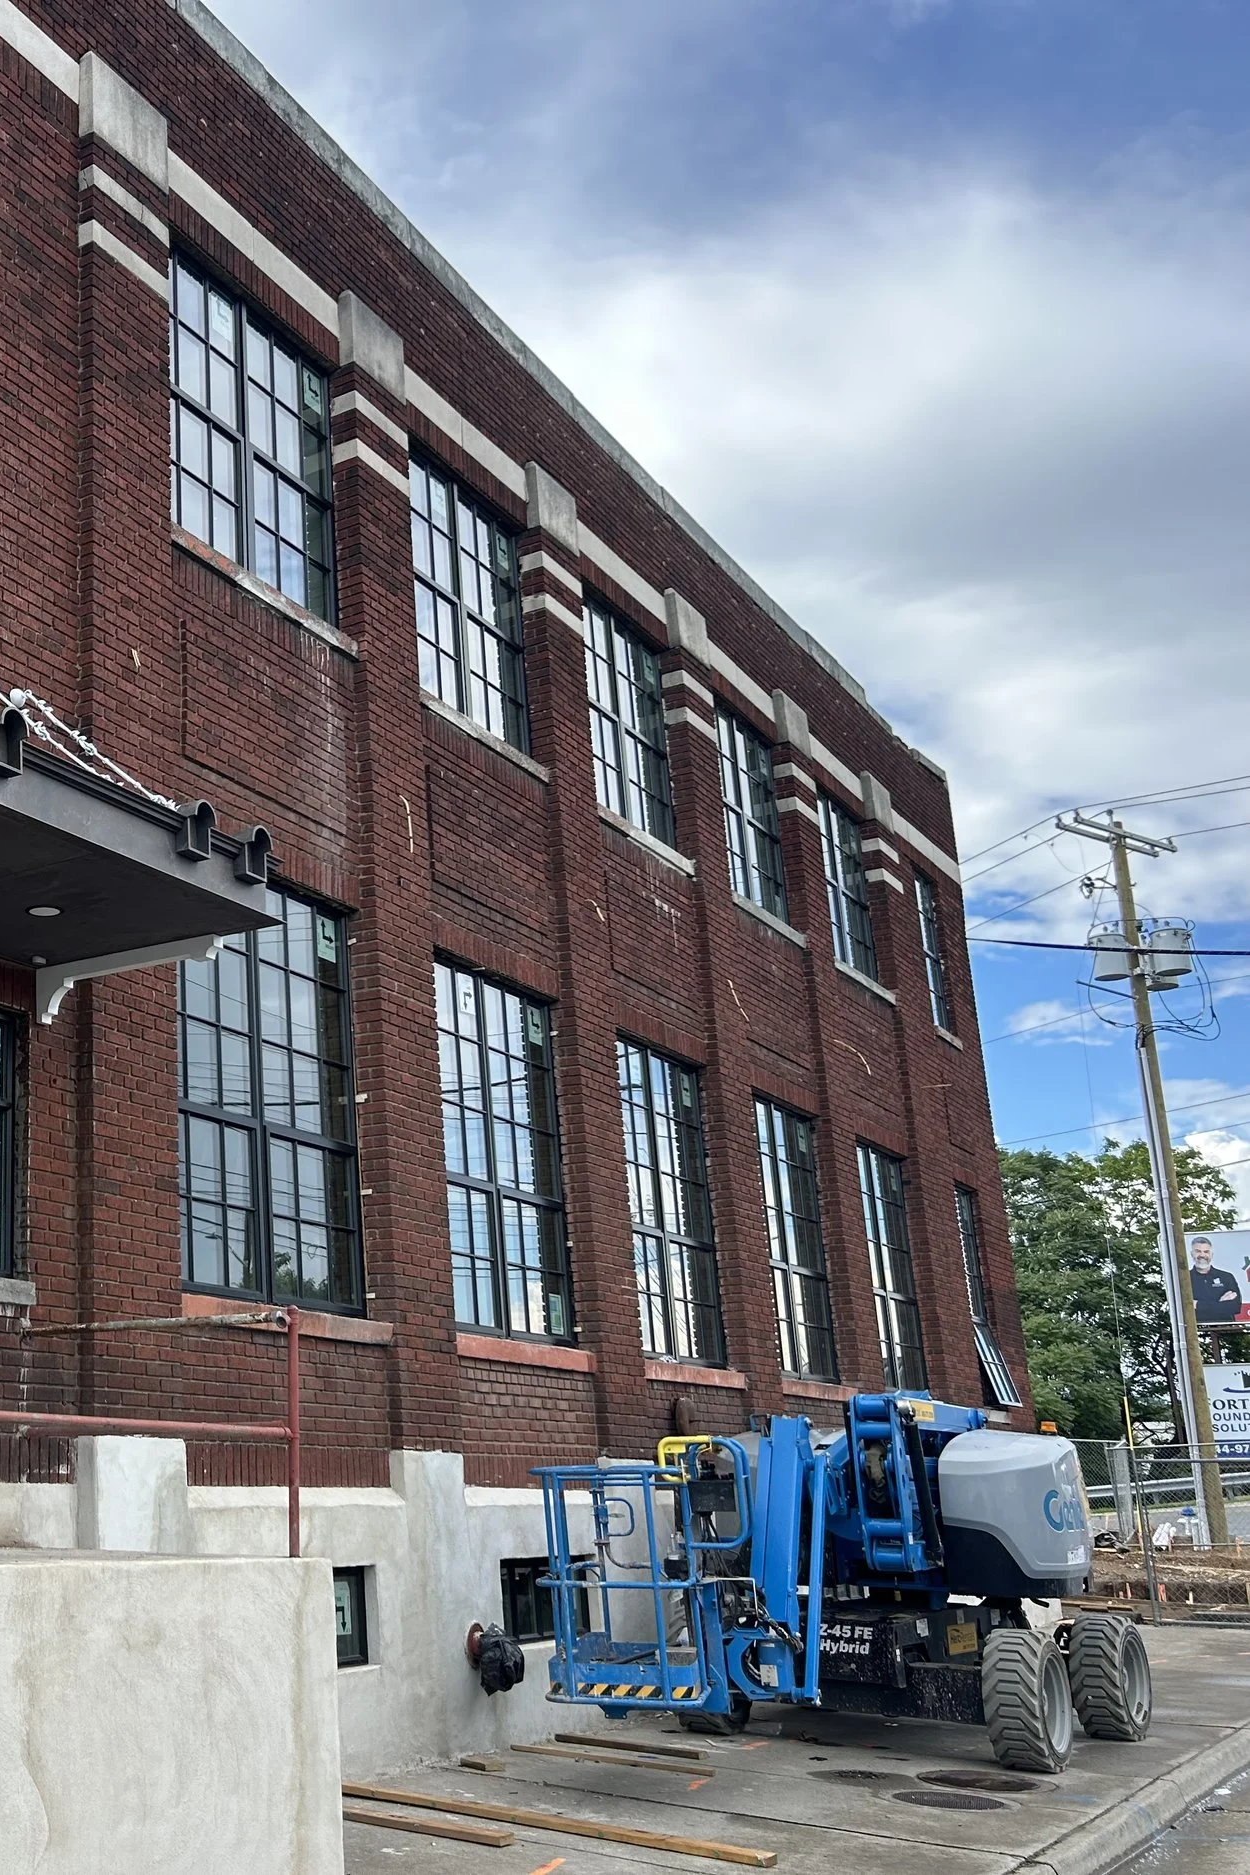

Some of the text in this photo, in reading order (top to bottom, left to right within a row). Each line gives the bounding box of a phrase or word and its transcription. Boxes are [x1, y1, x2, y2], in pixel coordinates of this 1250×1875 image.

[1212, 1412, 1250, 1422] OUND
[1212, 1423, 1250, 1433] SOLU
[819, 1623, 874, 1640] Z-45 FE
[819, 1638, 870, 1655] Hybrid
